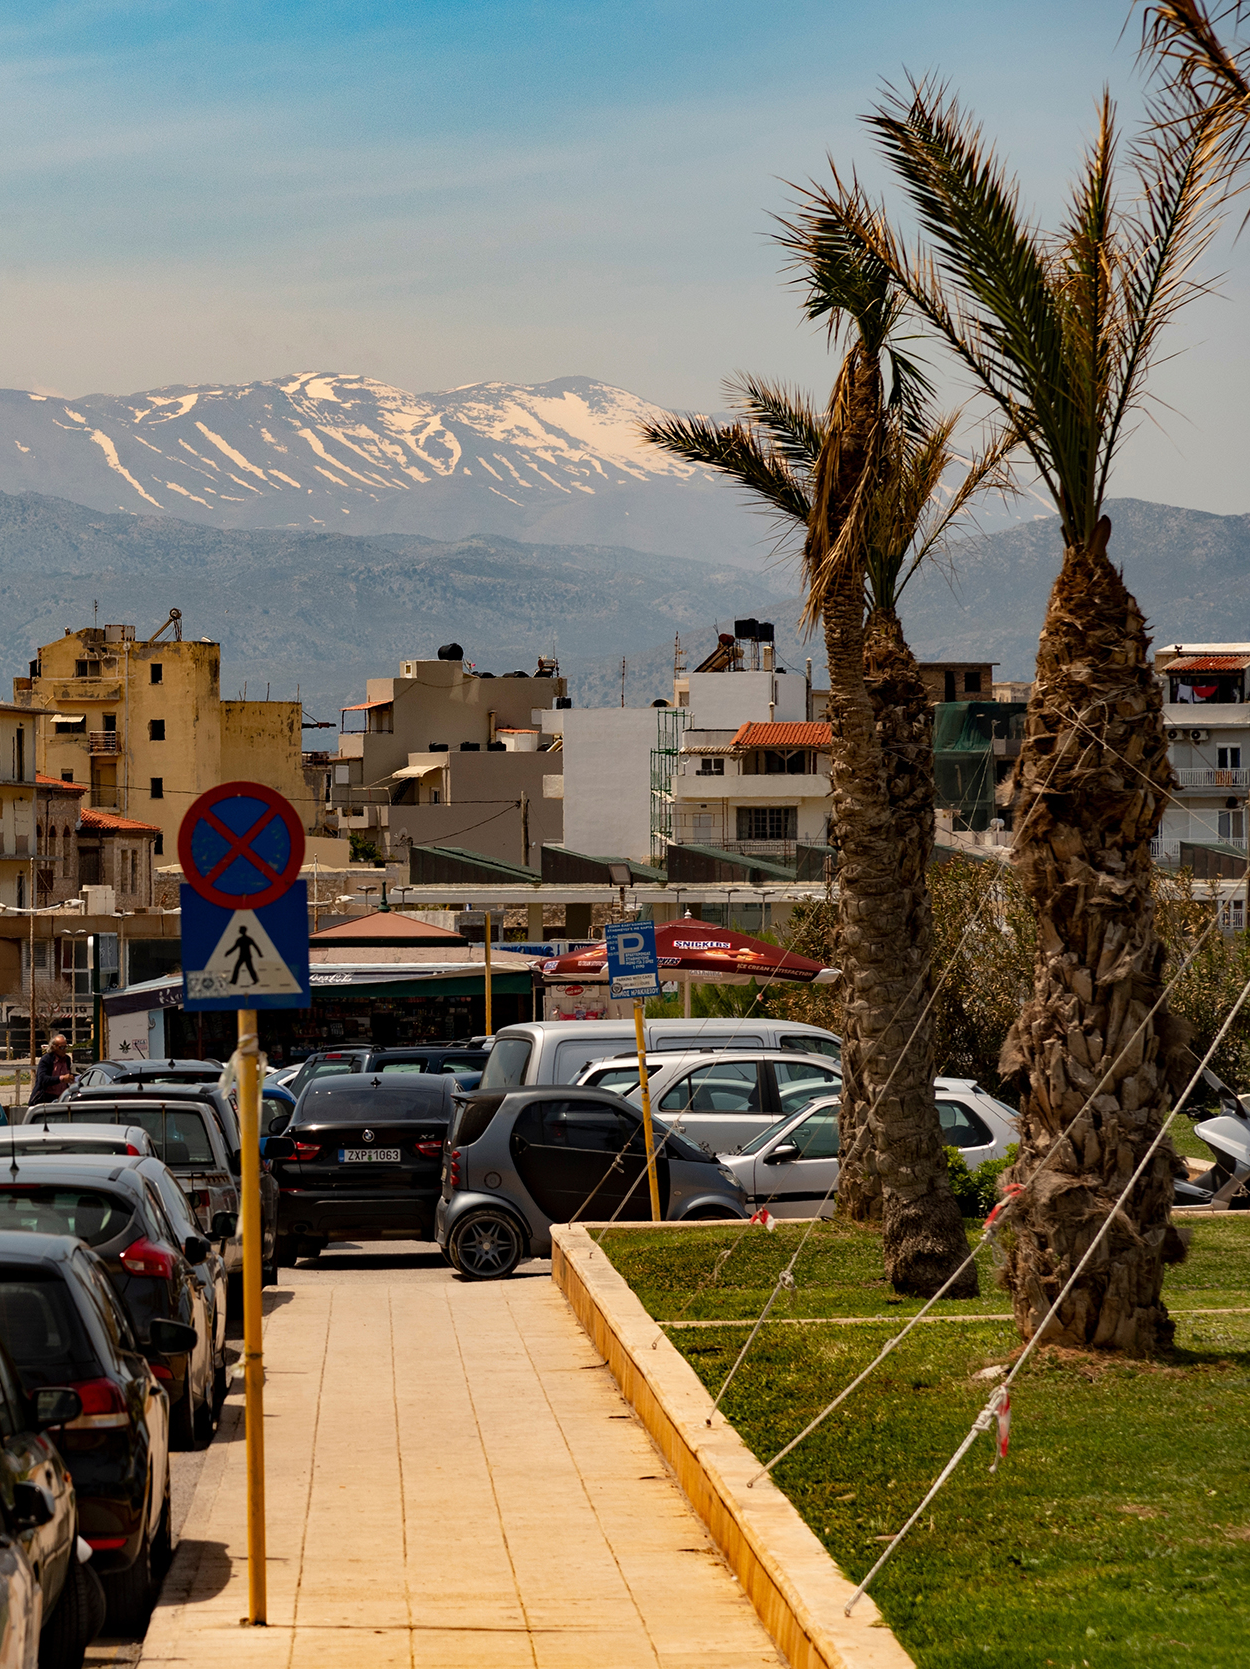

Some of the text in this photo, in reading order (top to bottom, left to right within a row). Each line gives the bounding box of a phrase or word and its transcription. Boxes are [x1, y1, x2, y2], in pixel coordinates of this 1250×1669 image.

[617, 932, 645, 965] P
[748, 964, 770, 972] CREAM
[770, 966, 814, 977] SATISFACTION
[631, 987, 660, 996] ΗΡΑΚΛΕΙΟΥ
